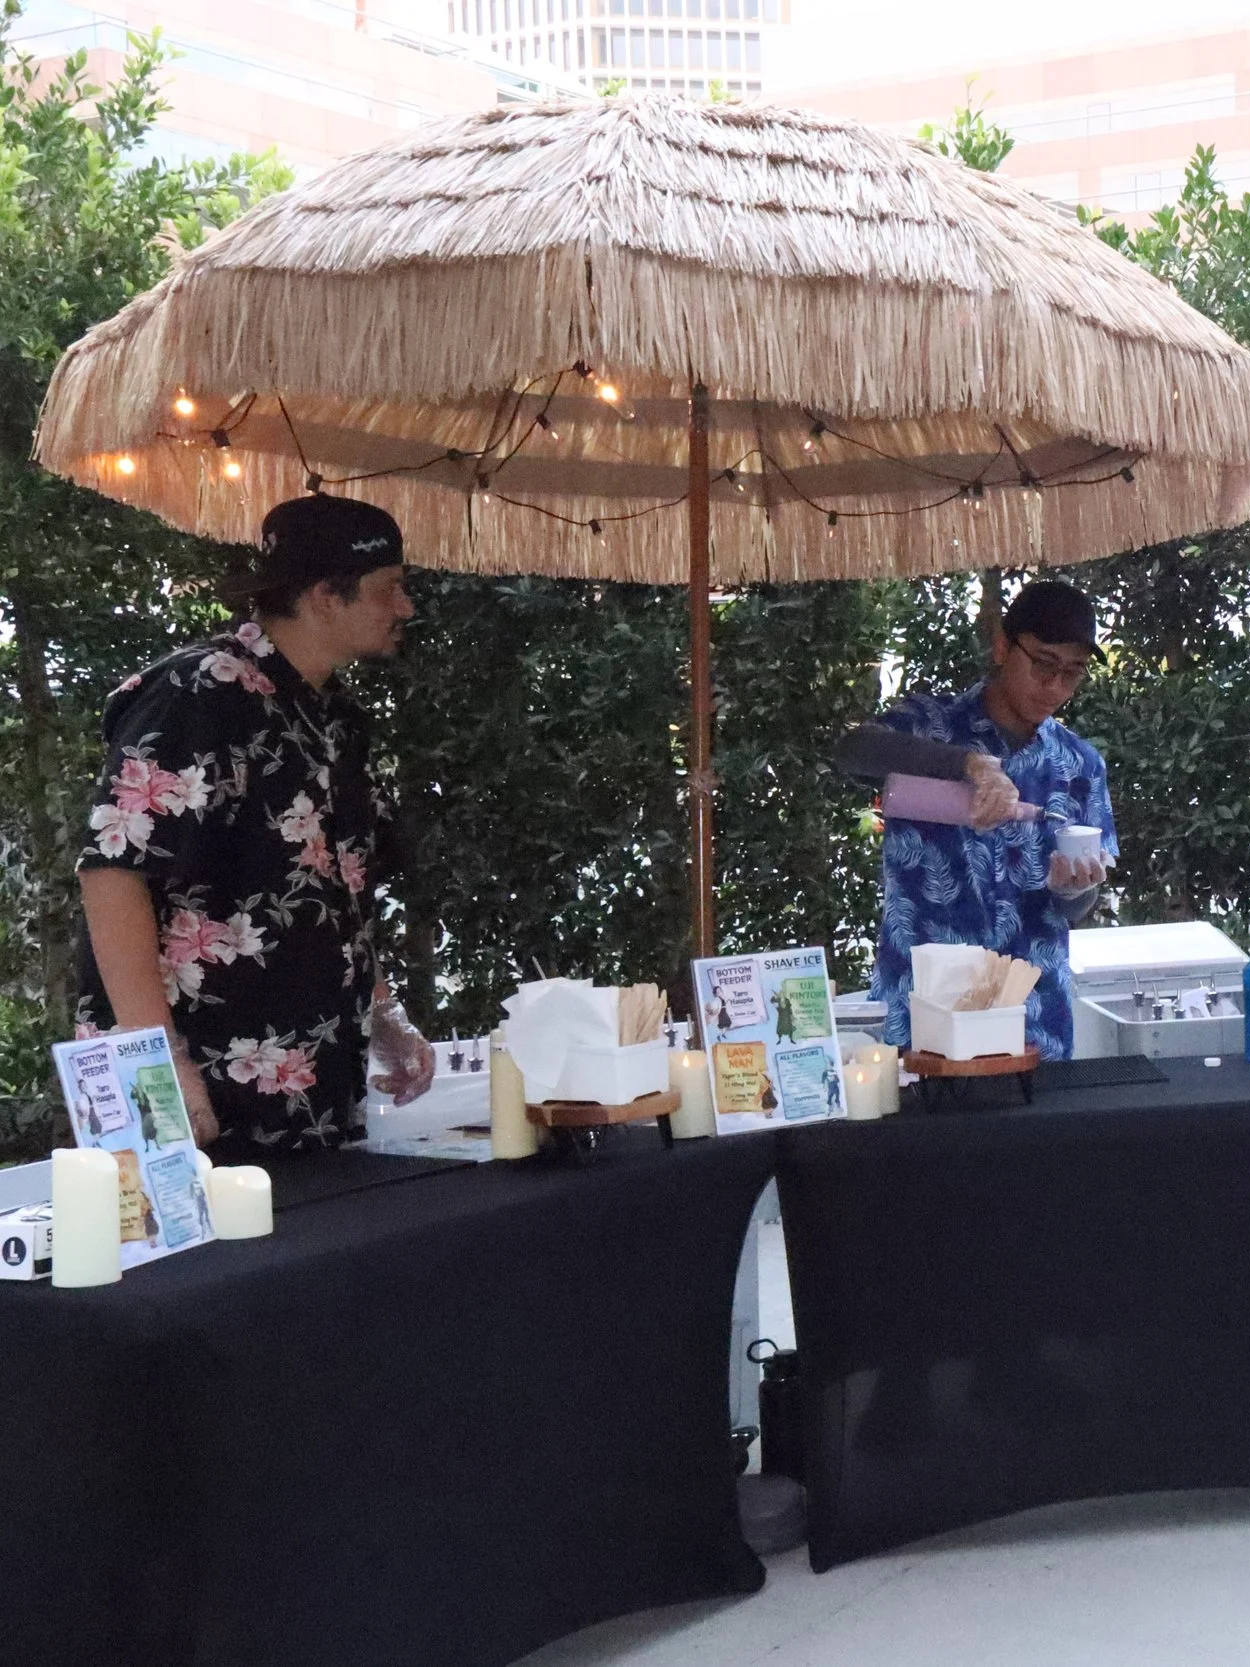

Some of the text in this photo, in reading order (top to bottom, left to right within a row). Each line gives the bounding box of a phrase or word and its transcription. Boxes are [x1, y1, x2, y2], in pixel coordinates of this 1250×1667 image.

[764, 955, 822, 970] SHAVE ICE
[716, 966, 752, 977] BOTTOM
[719, 975, 752, 985] FEEDER
[733, 990, 748, 998] Taro
[117, 1037, 166, 1057] SHAVE ICE
[726, 1047, 754, 1058] LAVA
[77, 1052, 107, 1067] BOTTOM
[729, 1058, 753, 1069] MAN
[81, 1064, 110, 1078] FEEDER
[9, 1240, 19, 1258] L
